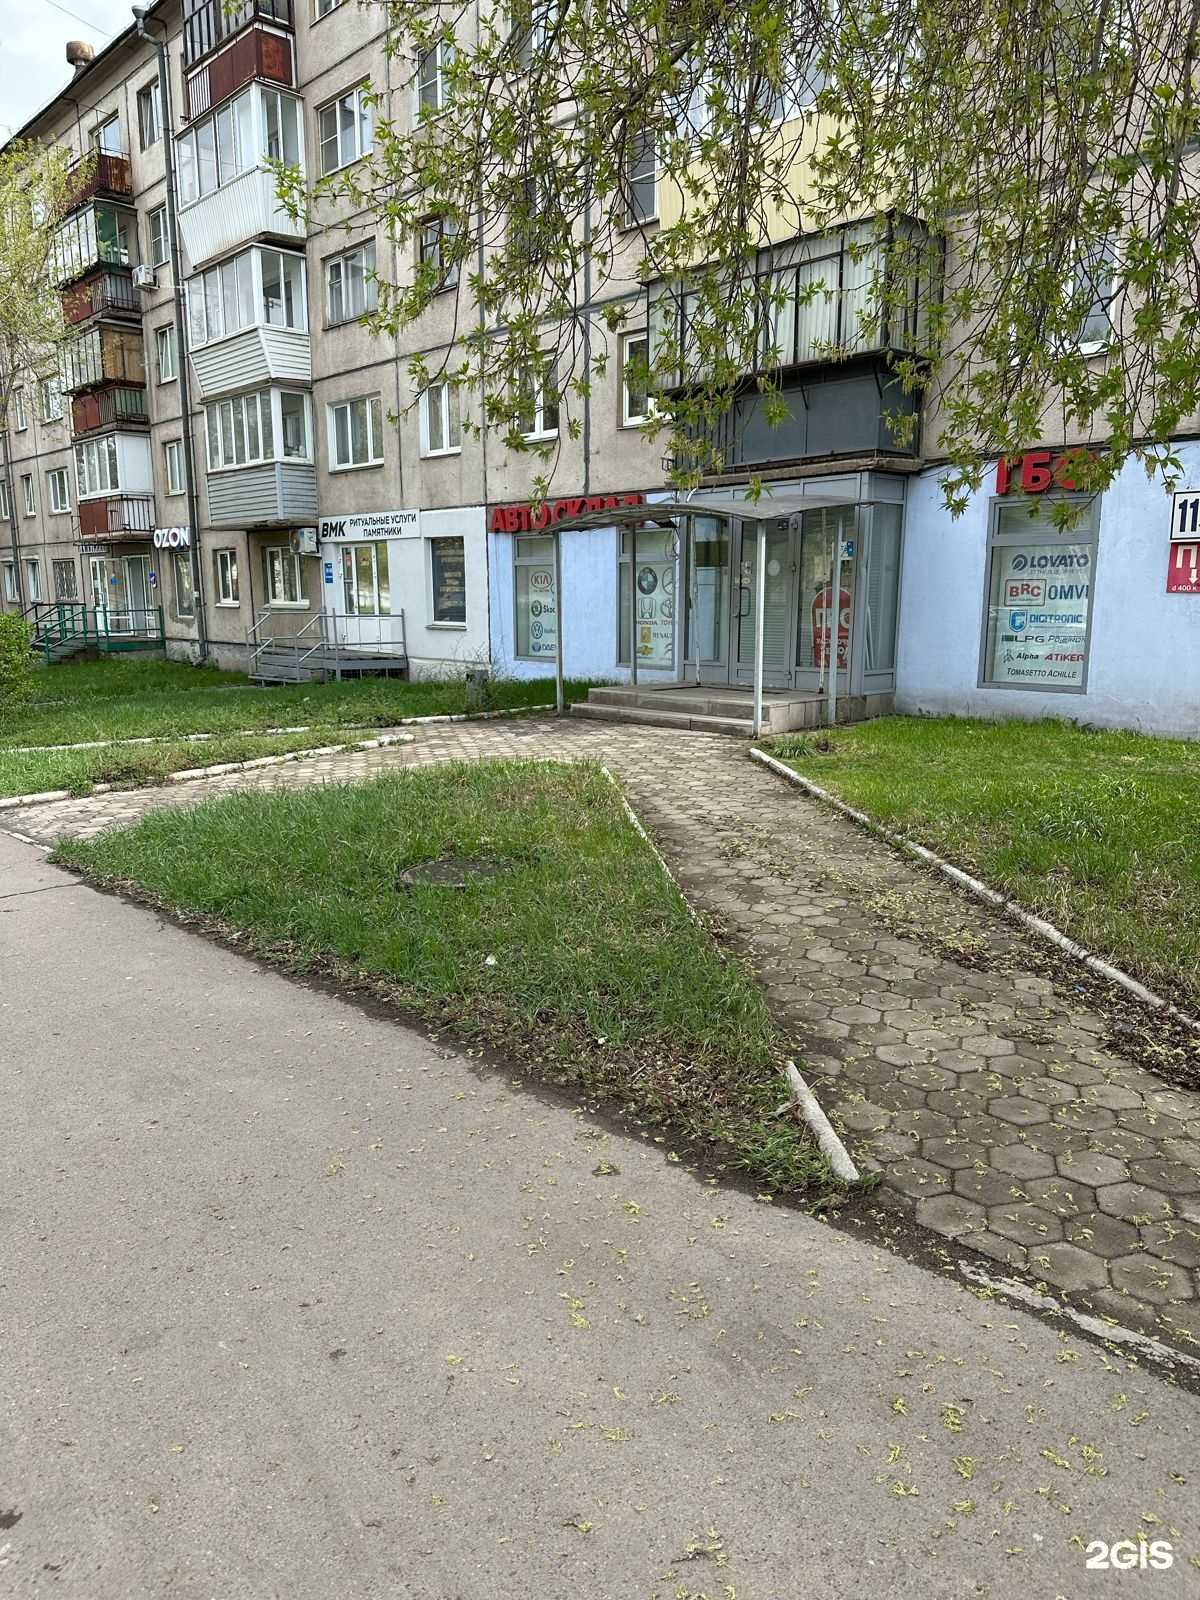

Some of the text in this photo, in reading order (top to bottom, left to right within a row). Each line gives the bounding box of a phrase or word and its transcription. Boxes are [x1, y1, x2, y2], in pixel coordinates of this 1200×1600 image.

[349, 513, 417, 527] РИТУАЛЬНЫЕ УСЛУГИ
[1179, 498, 1200, 533] 11
[321, 520, 346, 538] ВМК
[363, 526, 402, 537] ПАМЯТНИКИ
[153, 527, 191, 548] OZON
[1029, 553, 1089, 569] LOVATO
[534, 575, 549, 585] KIA
[1009, 583, 1041, 598] BRC
[1016, 652, 1039, 660] Alpha
[1007, 667, 1077, 679] TOMASETTO ACHILLE
